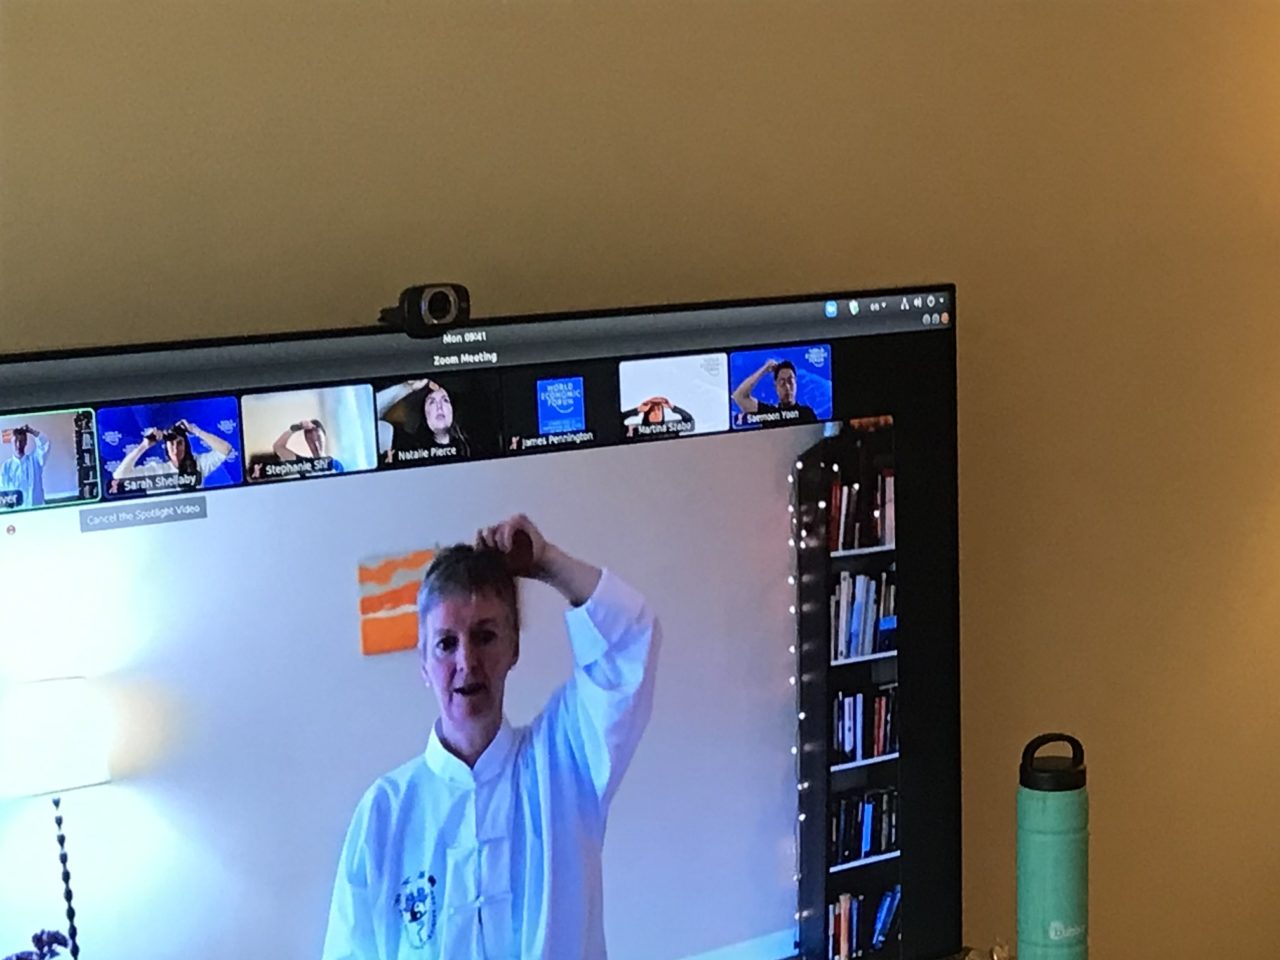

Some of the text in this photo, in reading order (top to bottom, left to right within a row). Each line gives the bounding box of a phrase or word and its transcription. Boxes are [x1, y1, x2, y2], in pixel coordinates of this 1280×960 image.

[443, 334, 463, 345] Mon
[434, 351, 497, 367] Zoom Meeting
[541, 390, 581, 400] ECONOMIC
[638, 424, 667, 435] Martina
[522, 431, 594, 450] James Pennington
[398, 445, 457, 461] Natalie Pierce
[266, 461, 312, 476] Stephanie
[124, 480, 154, 492] Sarah
[87, 504, 201, 526] Cancel the Spotlight Video
